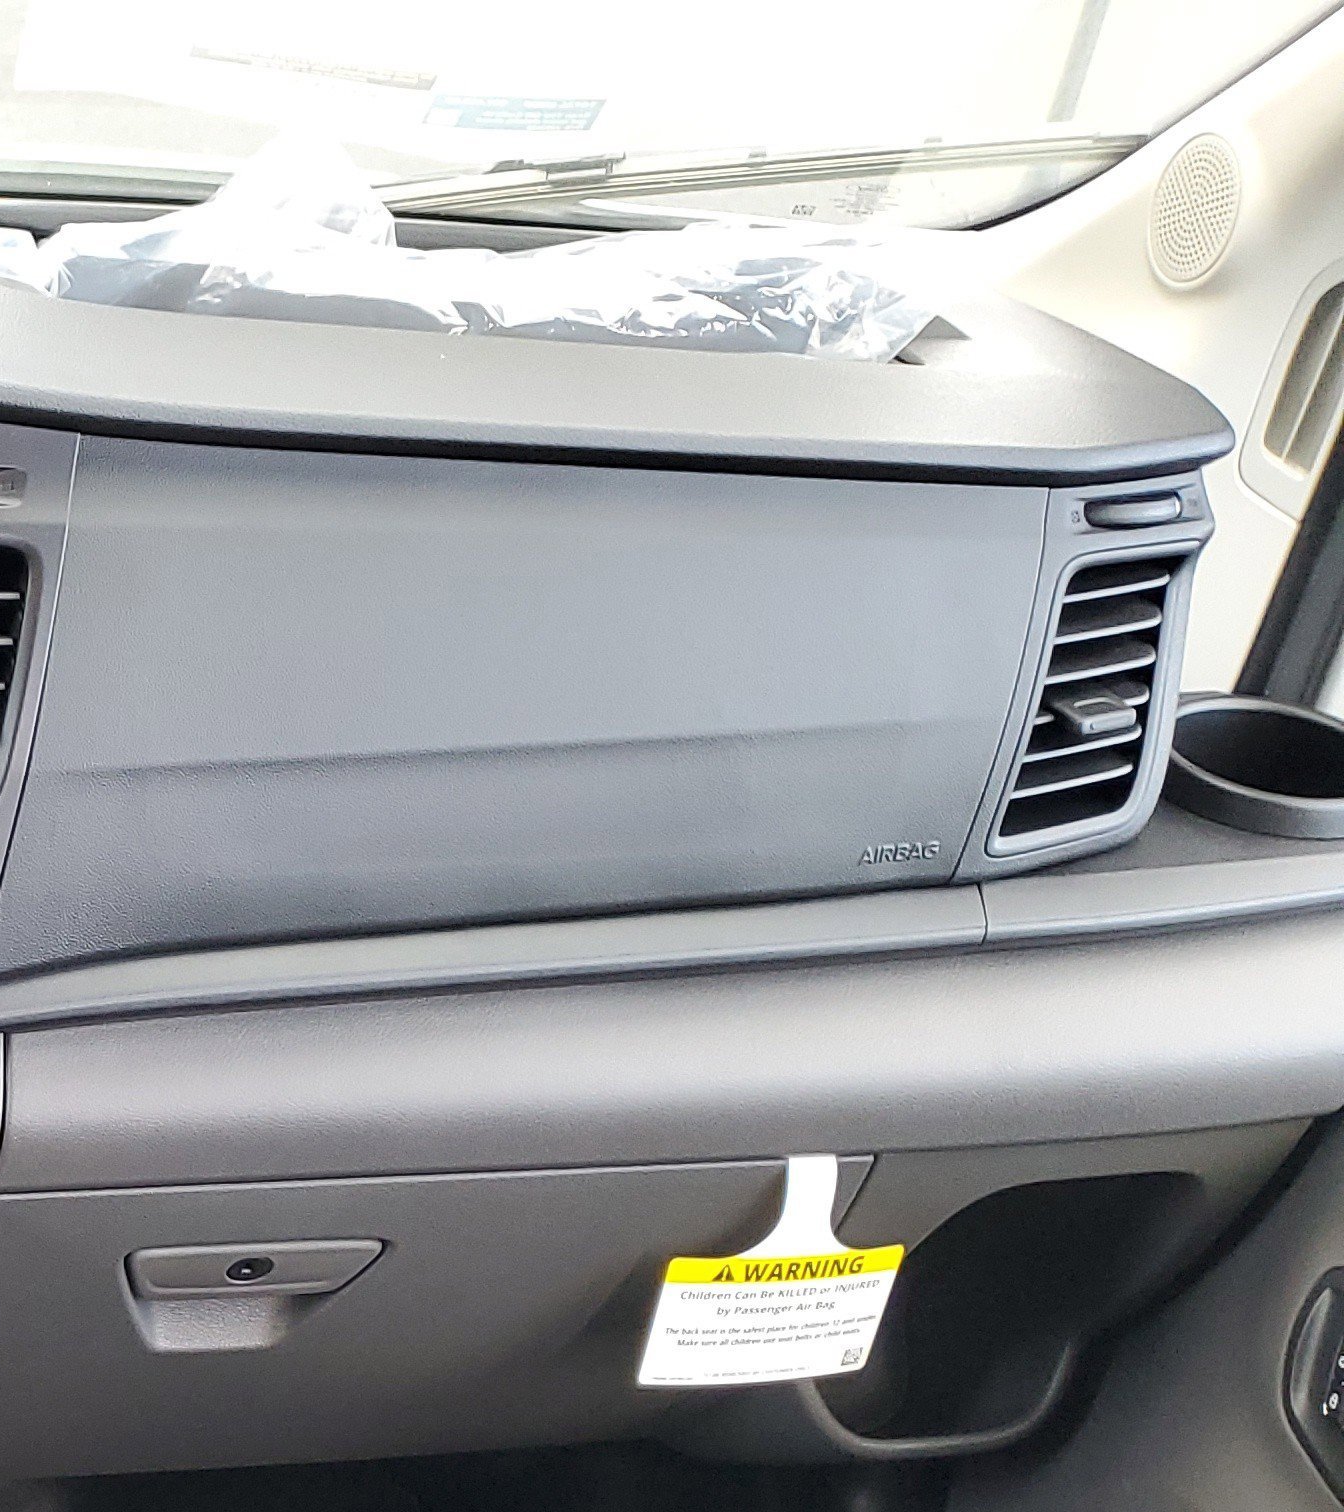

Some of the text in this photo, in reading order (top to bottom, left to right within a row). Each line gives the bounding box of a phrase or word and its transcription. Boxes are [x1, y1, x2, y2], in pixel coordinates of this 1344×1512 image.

[859, 840, 941, 865] AIRBAG
[744, 1256, 865, 1283] WARNING
[680, 1280, 880, 1300] Children Can Be KILLED or INJURED
[717, 1301, 835, 1317] by Passenger Air Bag
